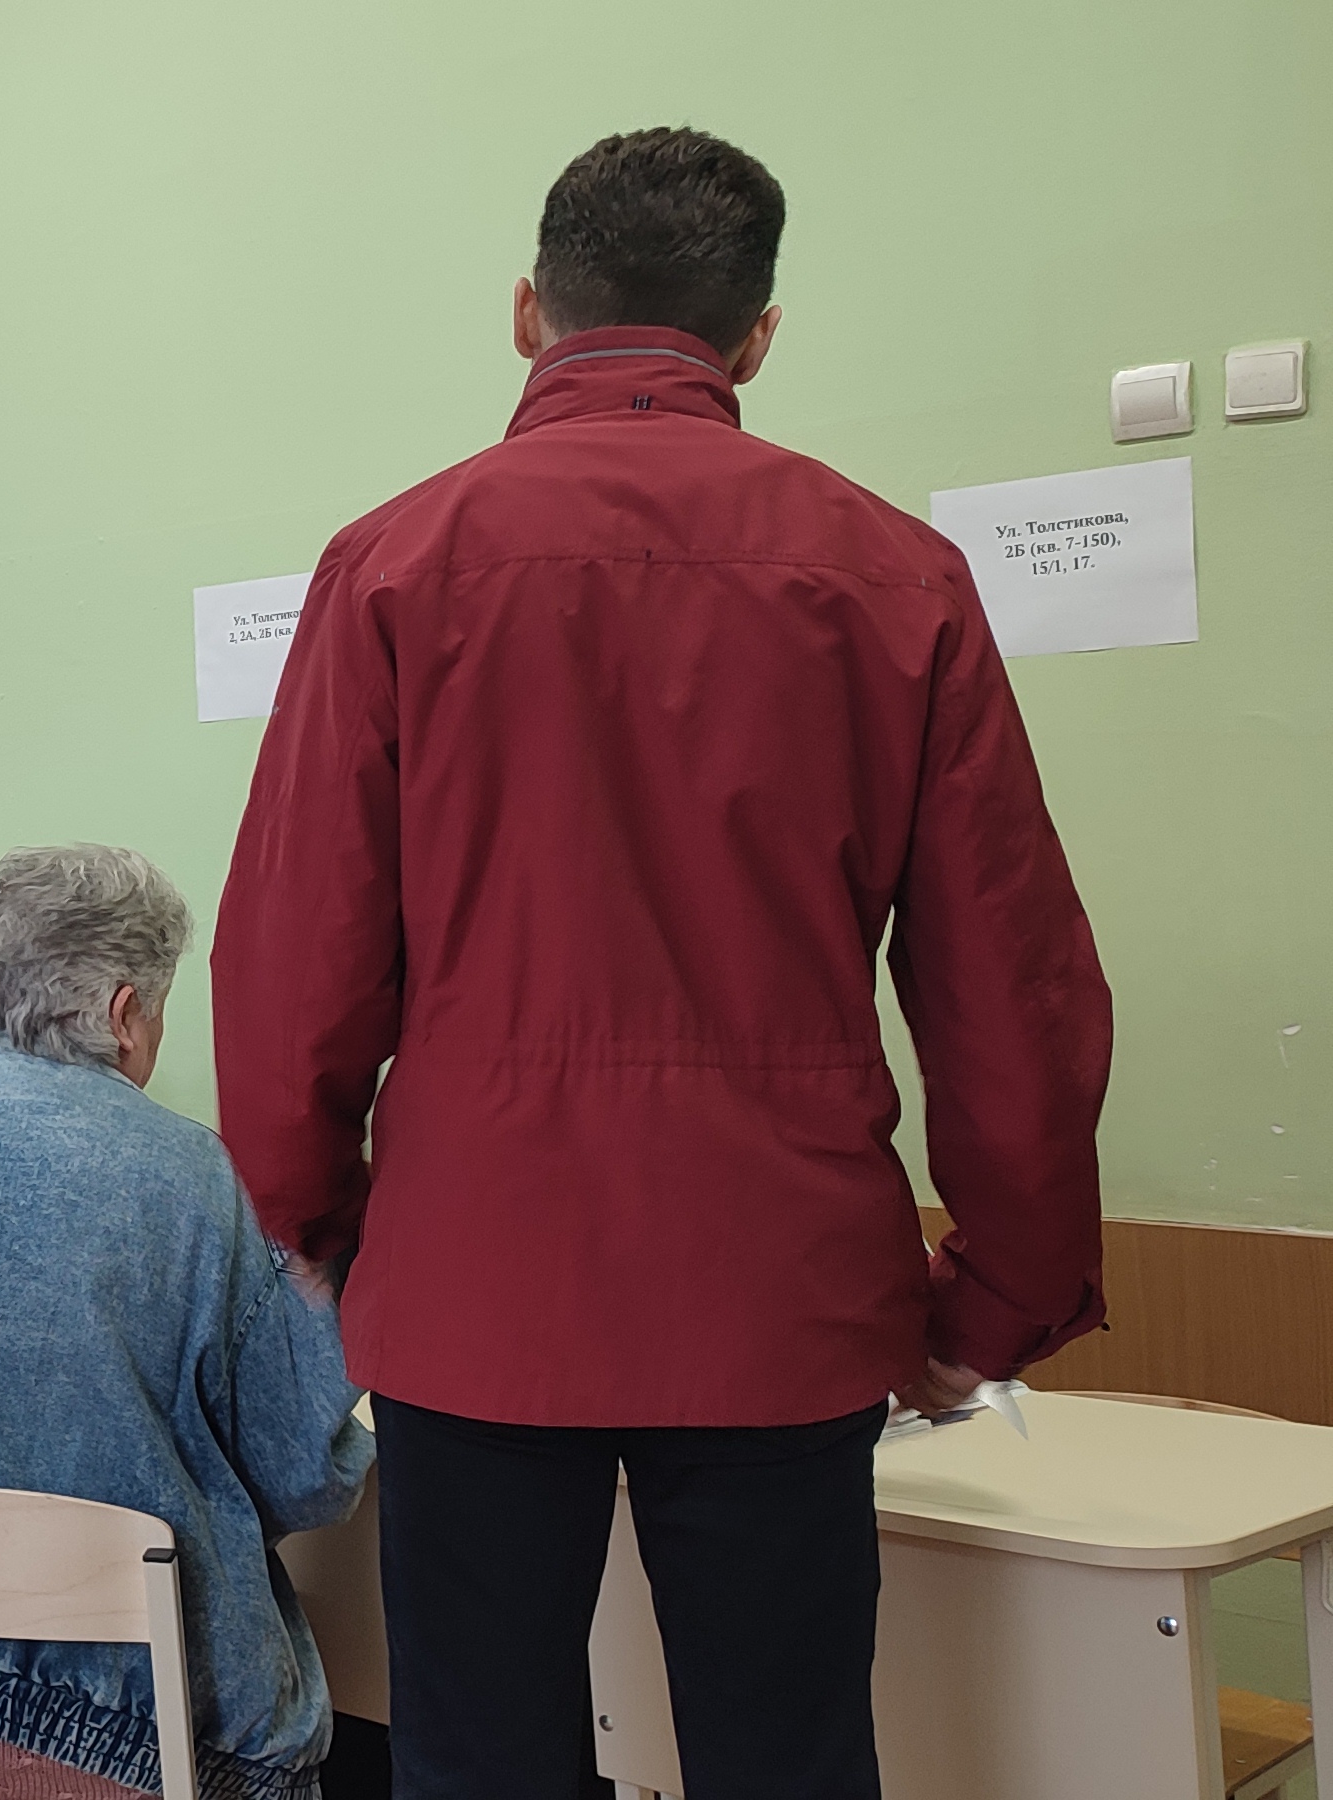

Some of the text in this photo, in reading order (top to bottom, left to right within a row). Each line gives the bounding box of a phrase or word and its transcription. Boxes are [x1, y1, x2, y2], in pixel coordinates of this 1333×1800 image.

[995, 511, 1129, 539] Ул. Толстикова,
[1005, 531, 1122, 558] 2Б (кв. 7-150),
[1032, 555, 1096, 576] 15/1, 17.
[233, 616, 249, 626] Ул.
[229, 627, 293, 644] 2, 2А, 2Б (кв.
